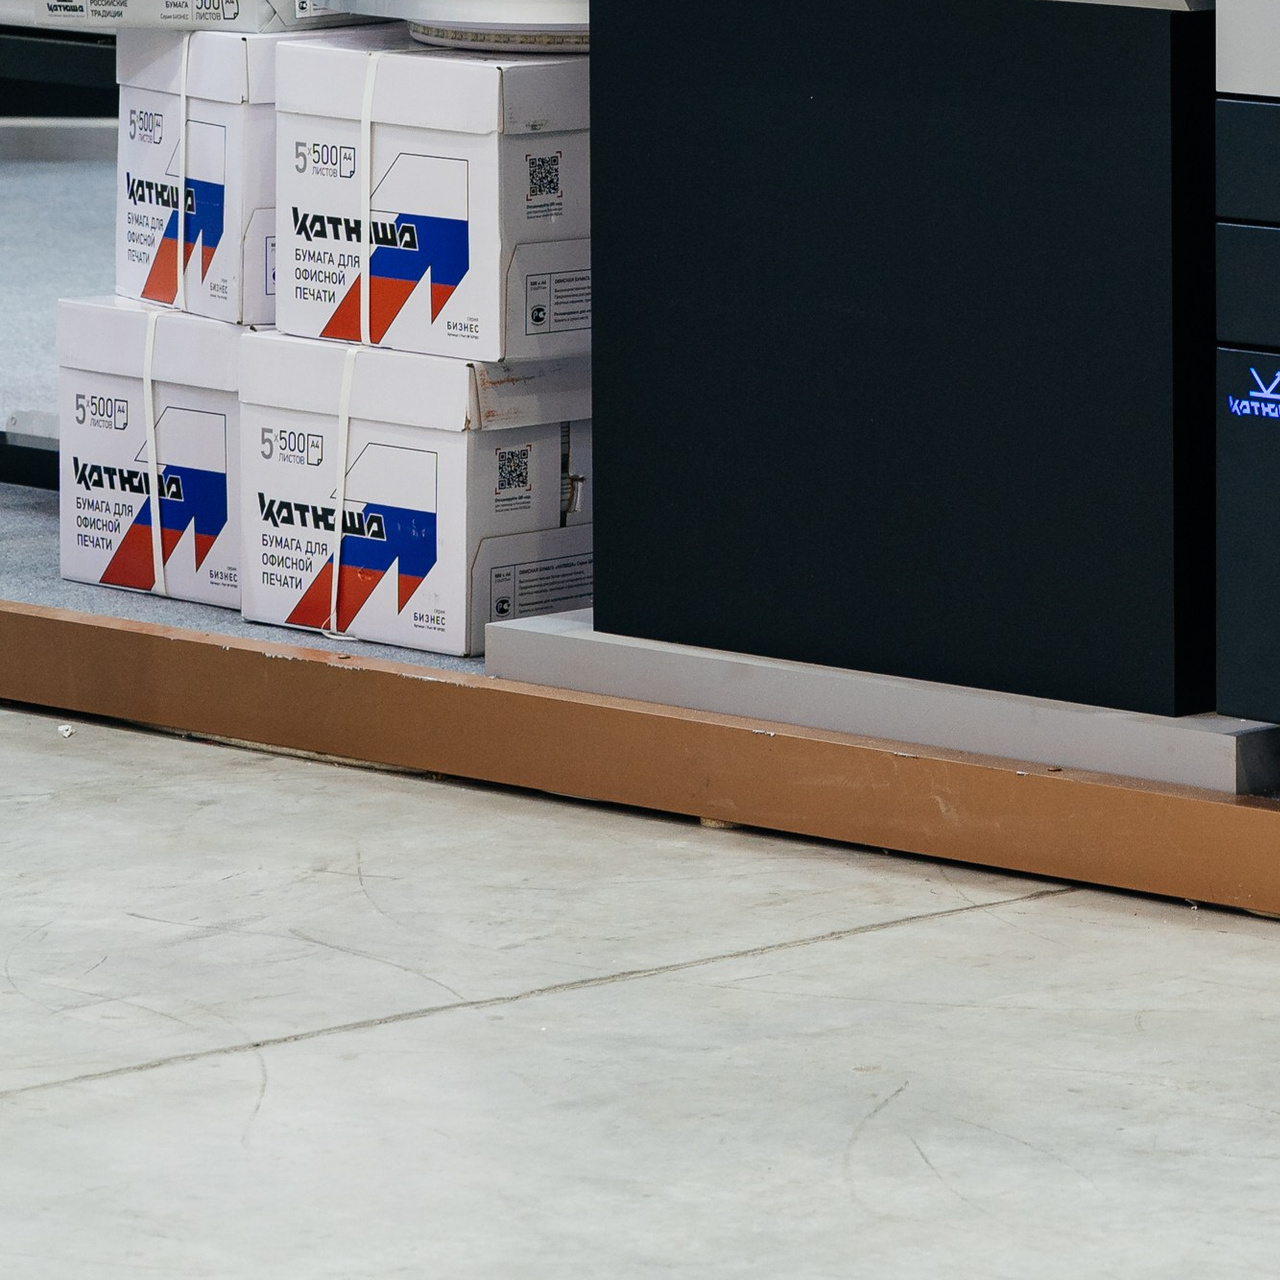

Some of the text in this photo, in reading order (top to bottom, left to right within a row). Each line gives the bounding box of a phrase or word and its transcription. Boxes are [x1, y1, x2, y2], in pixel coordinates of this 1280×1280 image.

[165, 1, 189, 9] БУМАГА
[91, 9, 123, 18] ТРАДИЦИИ
[195, 12, 221, 21] ЛИСТОВ
[343, 152, 352, 162] A4
[312, 166, 338, 178] ЛИСТОВ
[127, 212, 164, 231] БУМАГА ДЛЯ
[127, 231, 156, 248] ОФИСНОЙ
[127, 249, 150, 265] ПЕЧАТИ
[295, 248, 360, 269] БУМАГА ДЛЯ
[294, 267, 346, 286] ОФИСНОЙ
[295, 286, 336, 304] ПЕЧАТИ
[447, 321, 480, 334] БИЗНЕС
[117, 406, 126, 414] A4
[90, 418, 113, 430] ЛИСТОВ
[310, 440, 320, 450] A4
[278, 453, 305, 465] ЛИСТОВ
[76, 497, 134, 518] БУМАГА ДЛЯ
[76, 515, 121, 534] ОФИСНОЙ
[77, 533, 113, 551] ПЕЧАТИ
[262, 534, 328, 556] БУМАГА ДЛЯ
[262, 553, 313, 573] ОФИСНОЙ
[209, 569, 238, 583] БИЗНЕС
[262, 572, 303, 591] ПЕЧАТИ
[413, 612, 446, 626] БИЗНЕС
